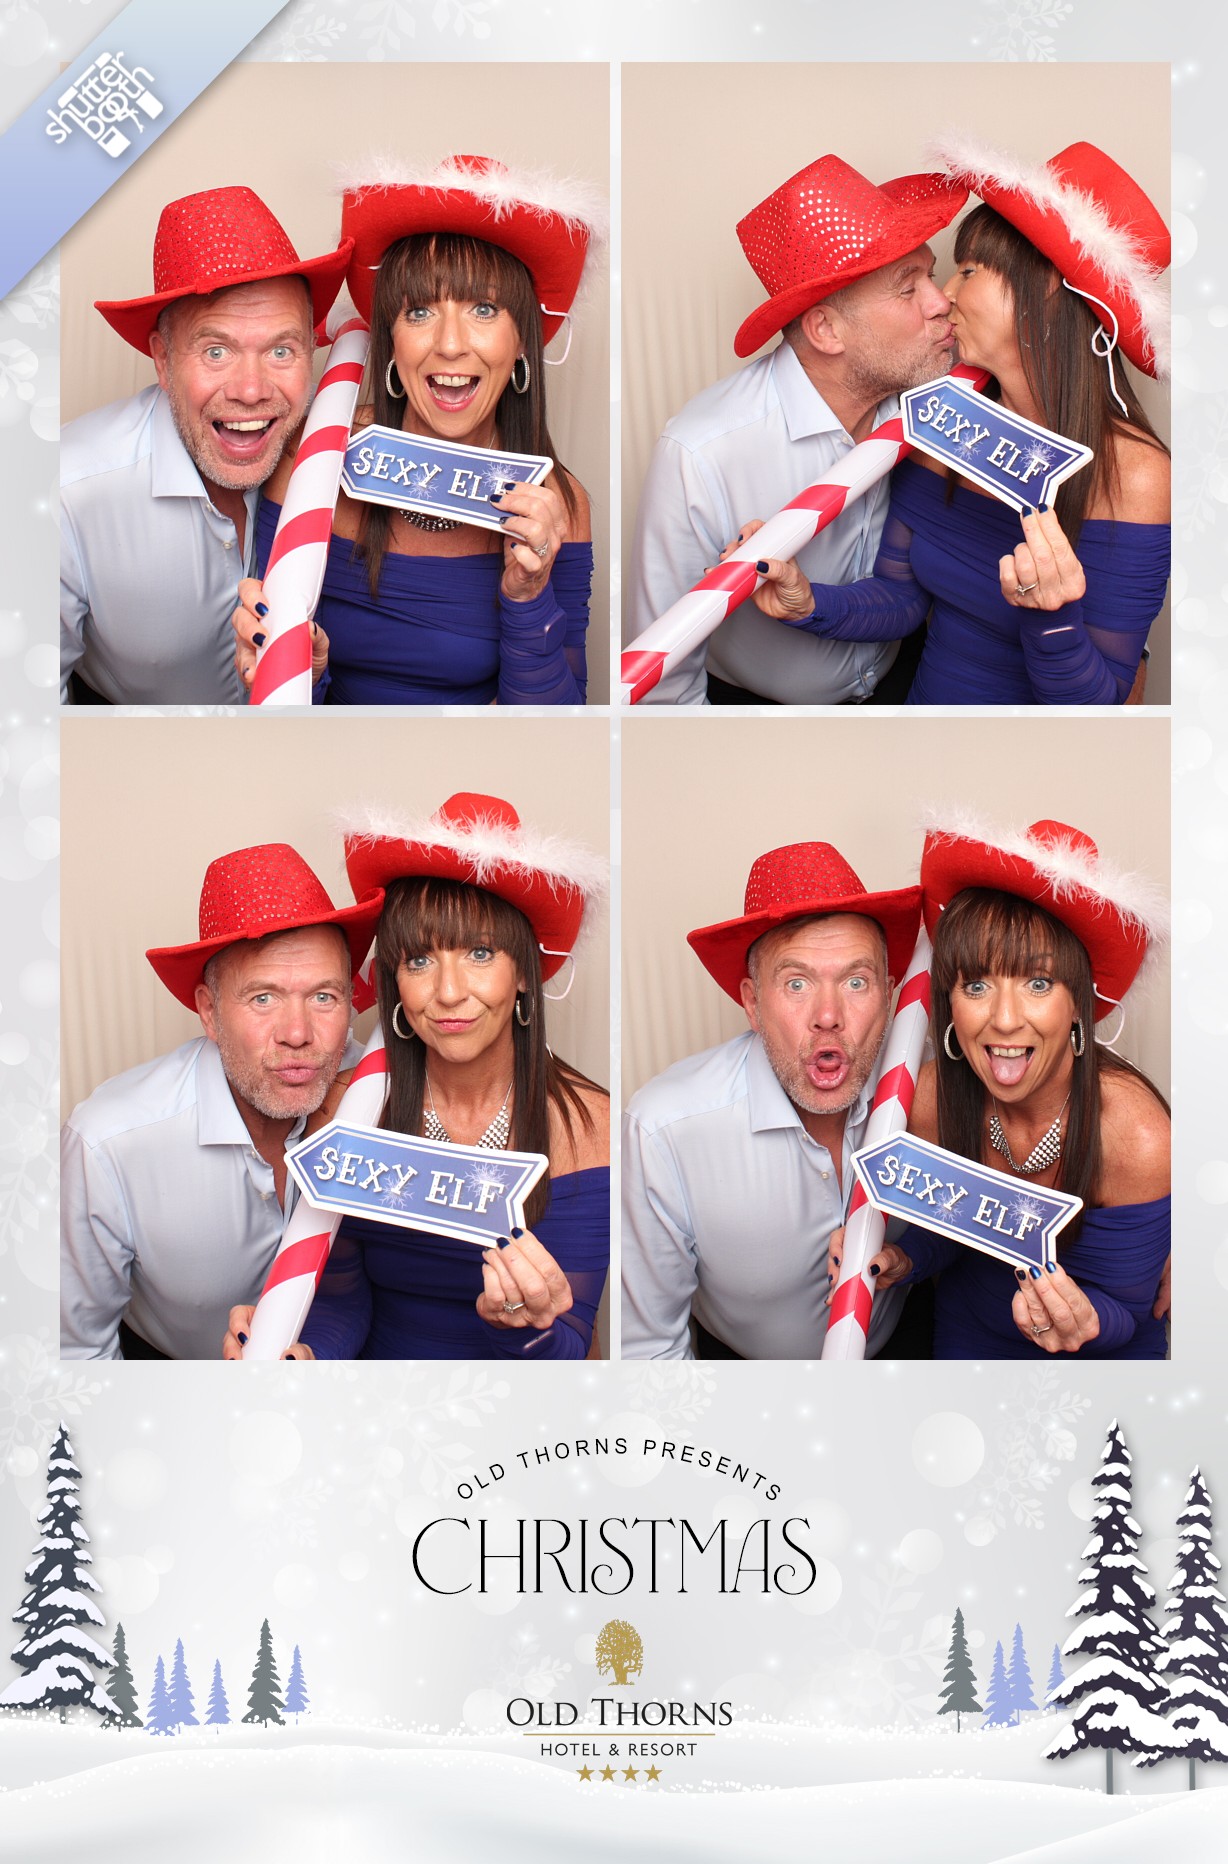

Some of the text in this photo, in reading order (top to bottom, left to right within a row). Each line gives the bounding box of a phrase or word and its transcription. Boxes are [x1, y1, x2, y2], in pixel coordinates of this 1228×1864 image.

[352, 447, 443, 488] SEXY
[917, 396, 1049, 484] SEXY ELF
[313, 1146, 504, 1214] SEXY ELF
[876, 1155, 1042, 1241] SEXY ELF
